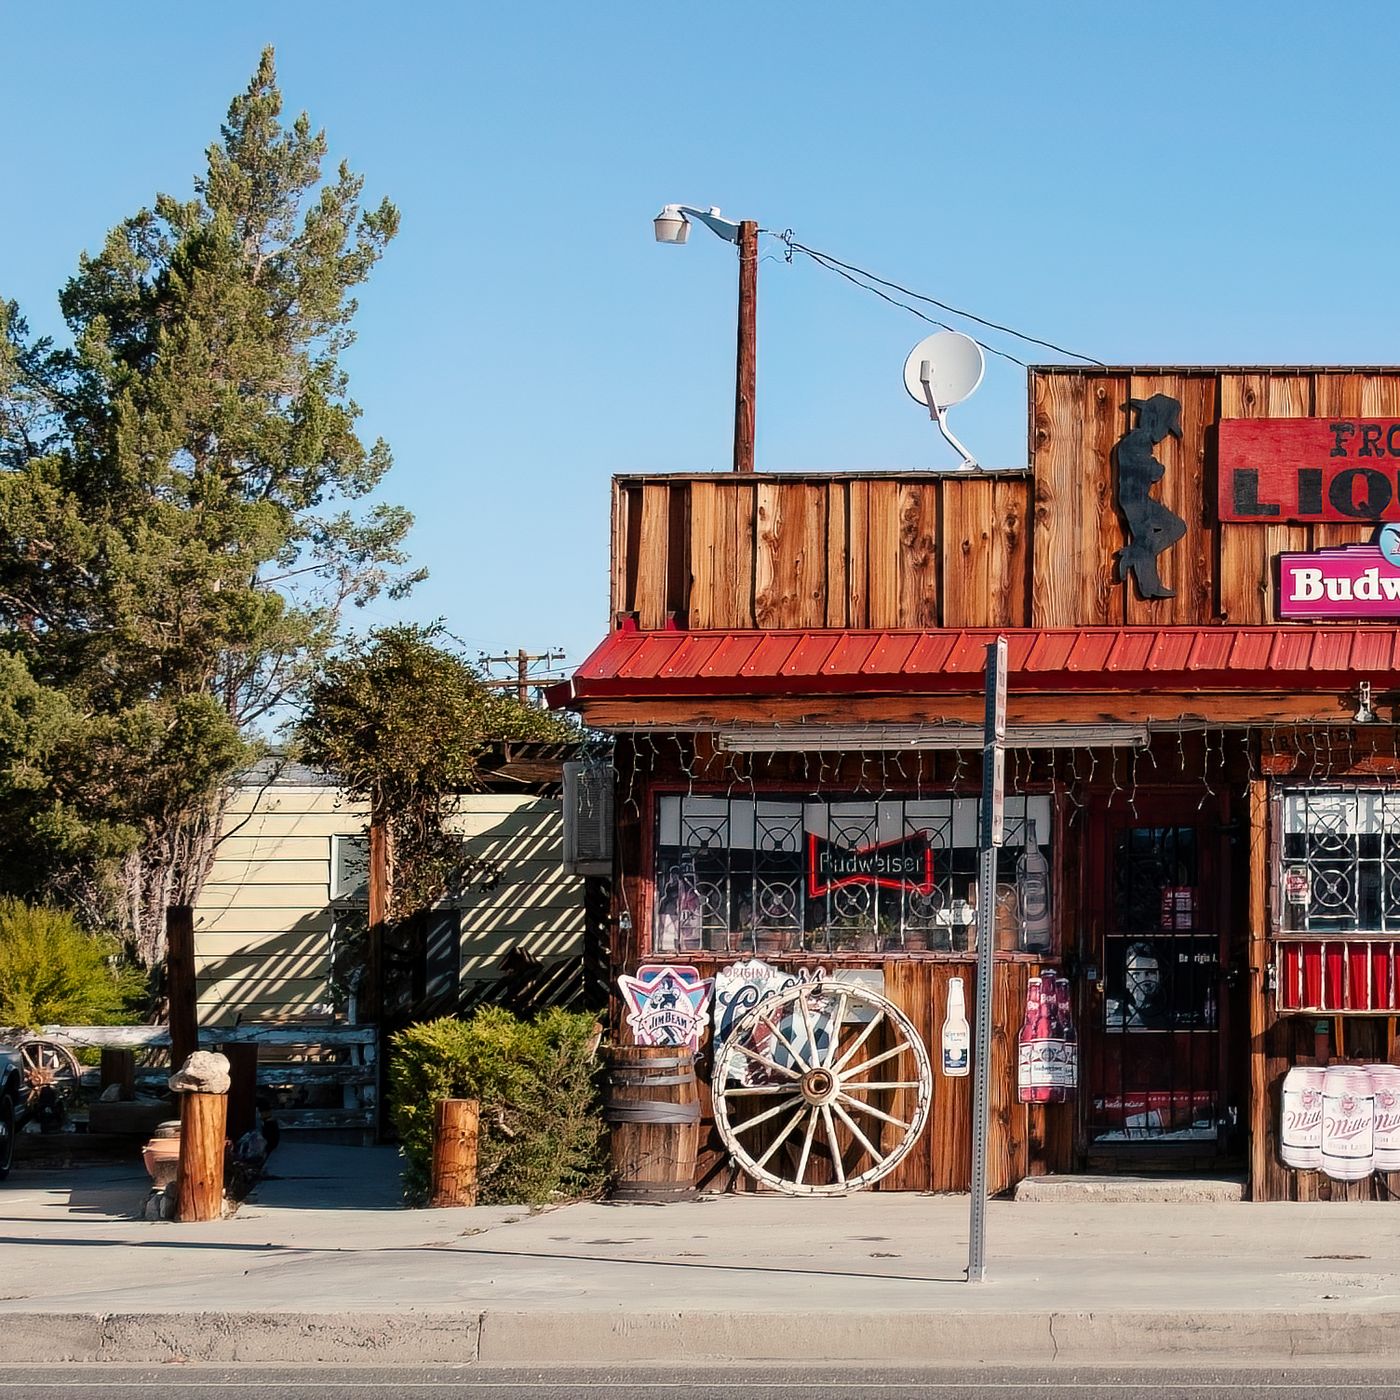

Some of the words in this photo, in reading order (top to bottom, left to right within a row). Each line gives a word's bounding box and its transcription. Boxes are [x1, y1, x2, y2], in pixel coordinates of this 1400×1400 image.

[820, 850, 922, 873] Budweiser
[722, 966, 778, 979] ORIGINAL
[649, 1015, 665, 1030] JIM
[665, 1011, 687, 1028] BEAM
[1287, 1110, 1322, 1129] Mill
[1326, 1117, 1372, 1137] Miller
